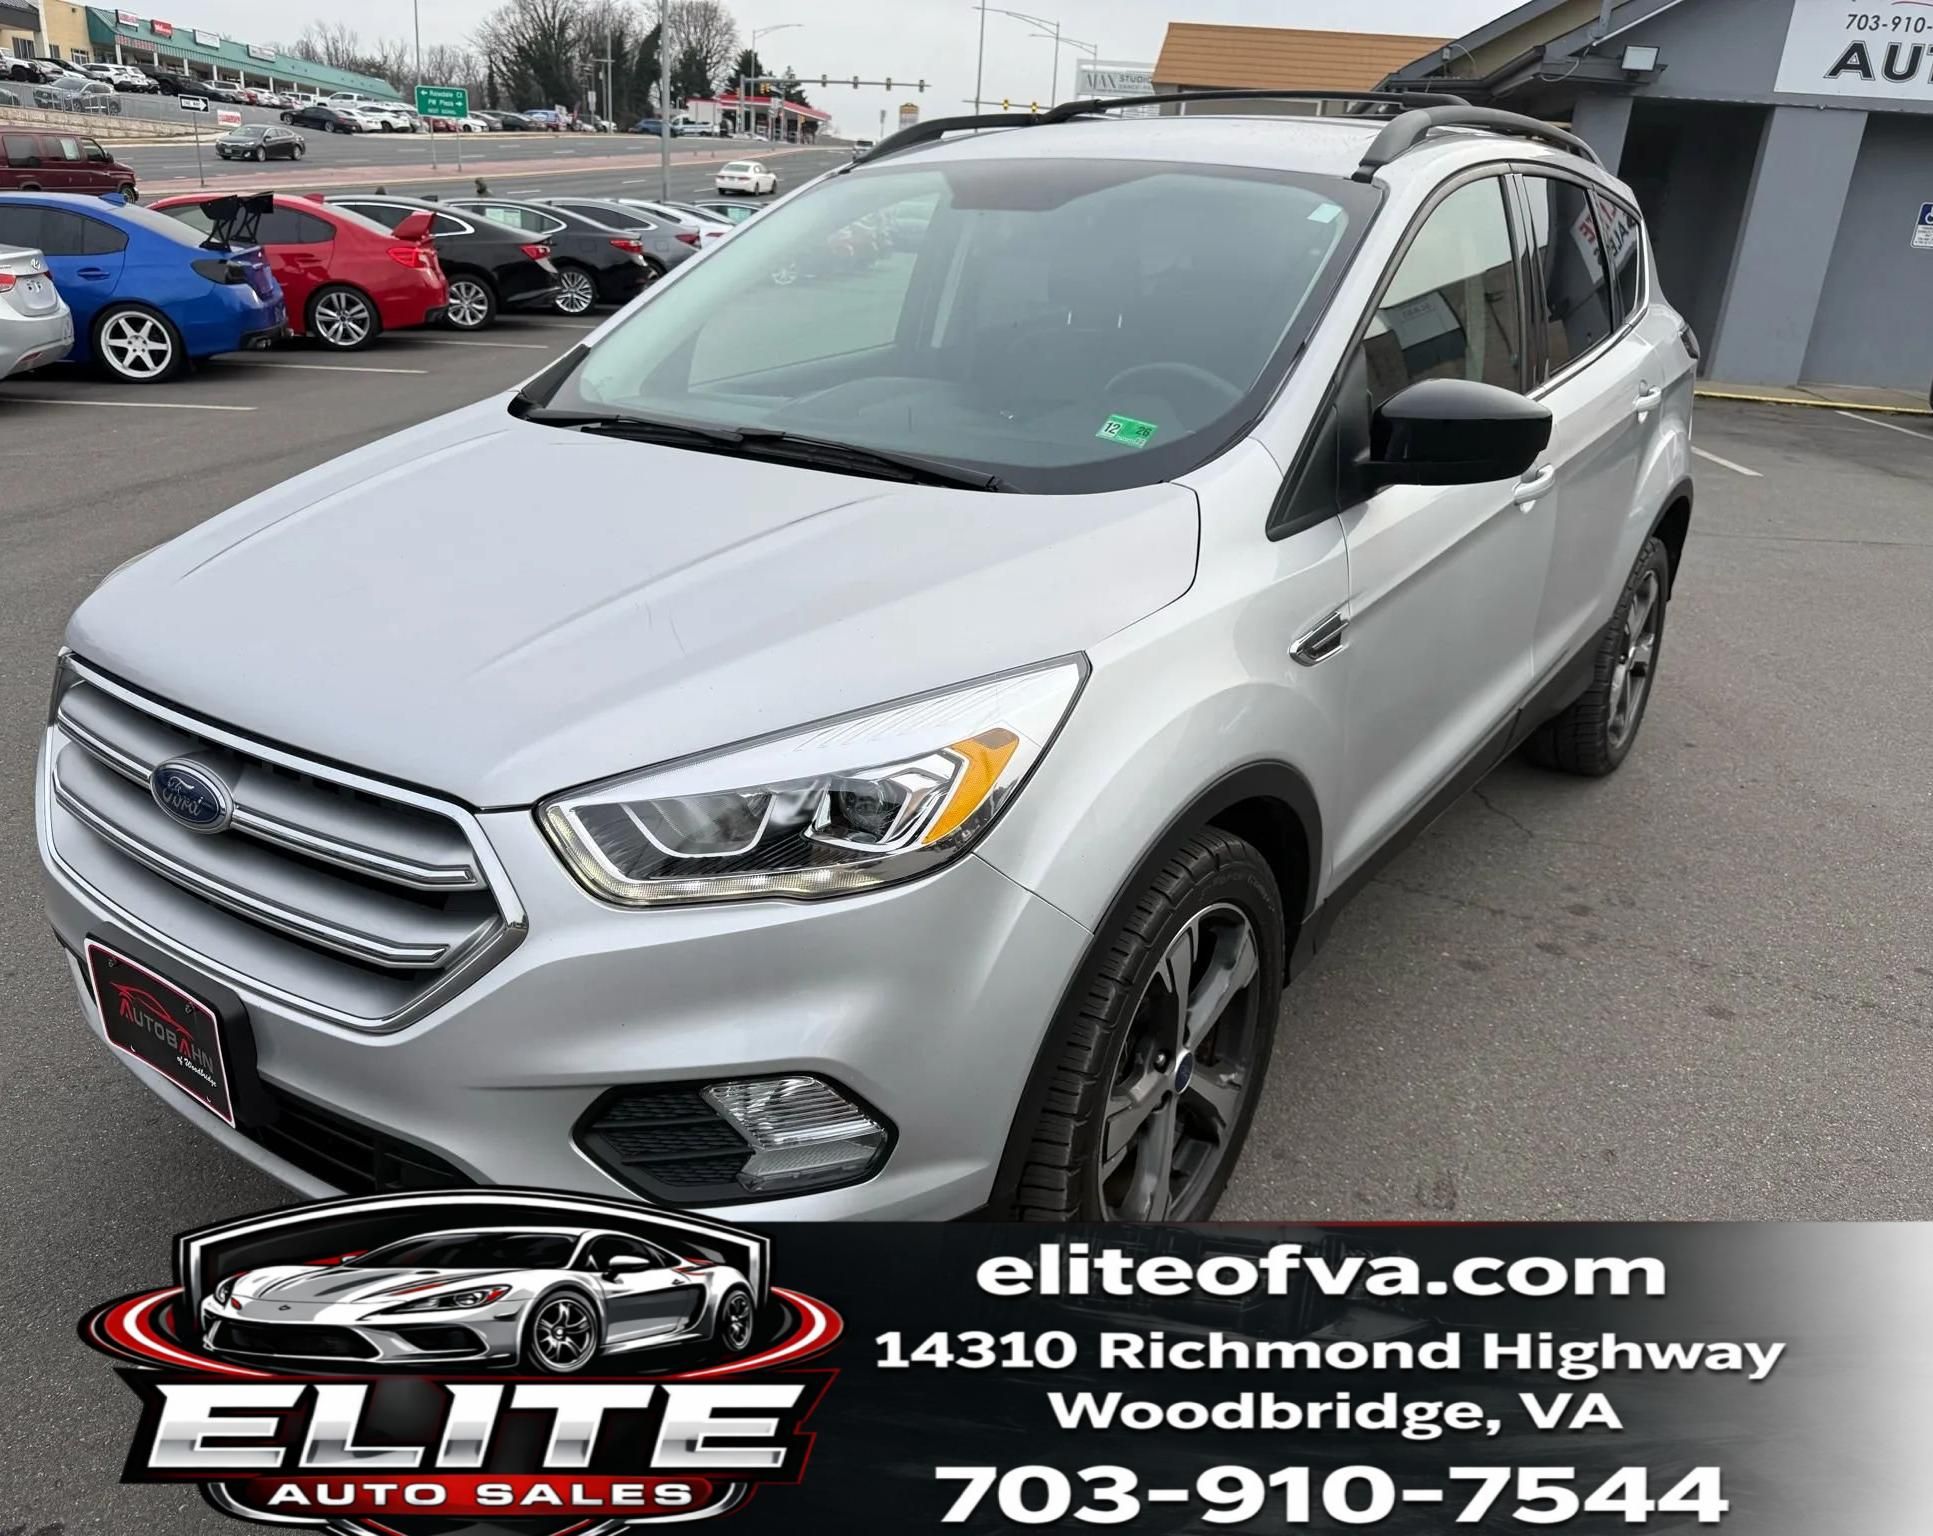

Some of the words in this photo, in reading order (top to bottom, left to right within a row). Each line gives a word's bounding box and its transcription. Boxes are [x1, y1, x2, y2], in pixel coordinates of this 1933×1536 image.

[1104, 422, 1121, 434] 12
[1135, 426, 1152, 438] 26
[119, 995, 214, 1075] AUTOBAHN
